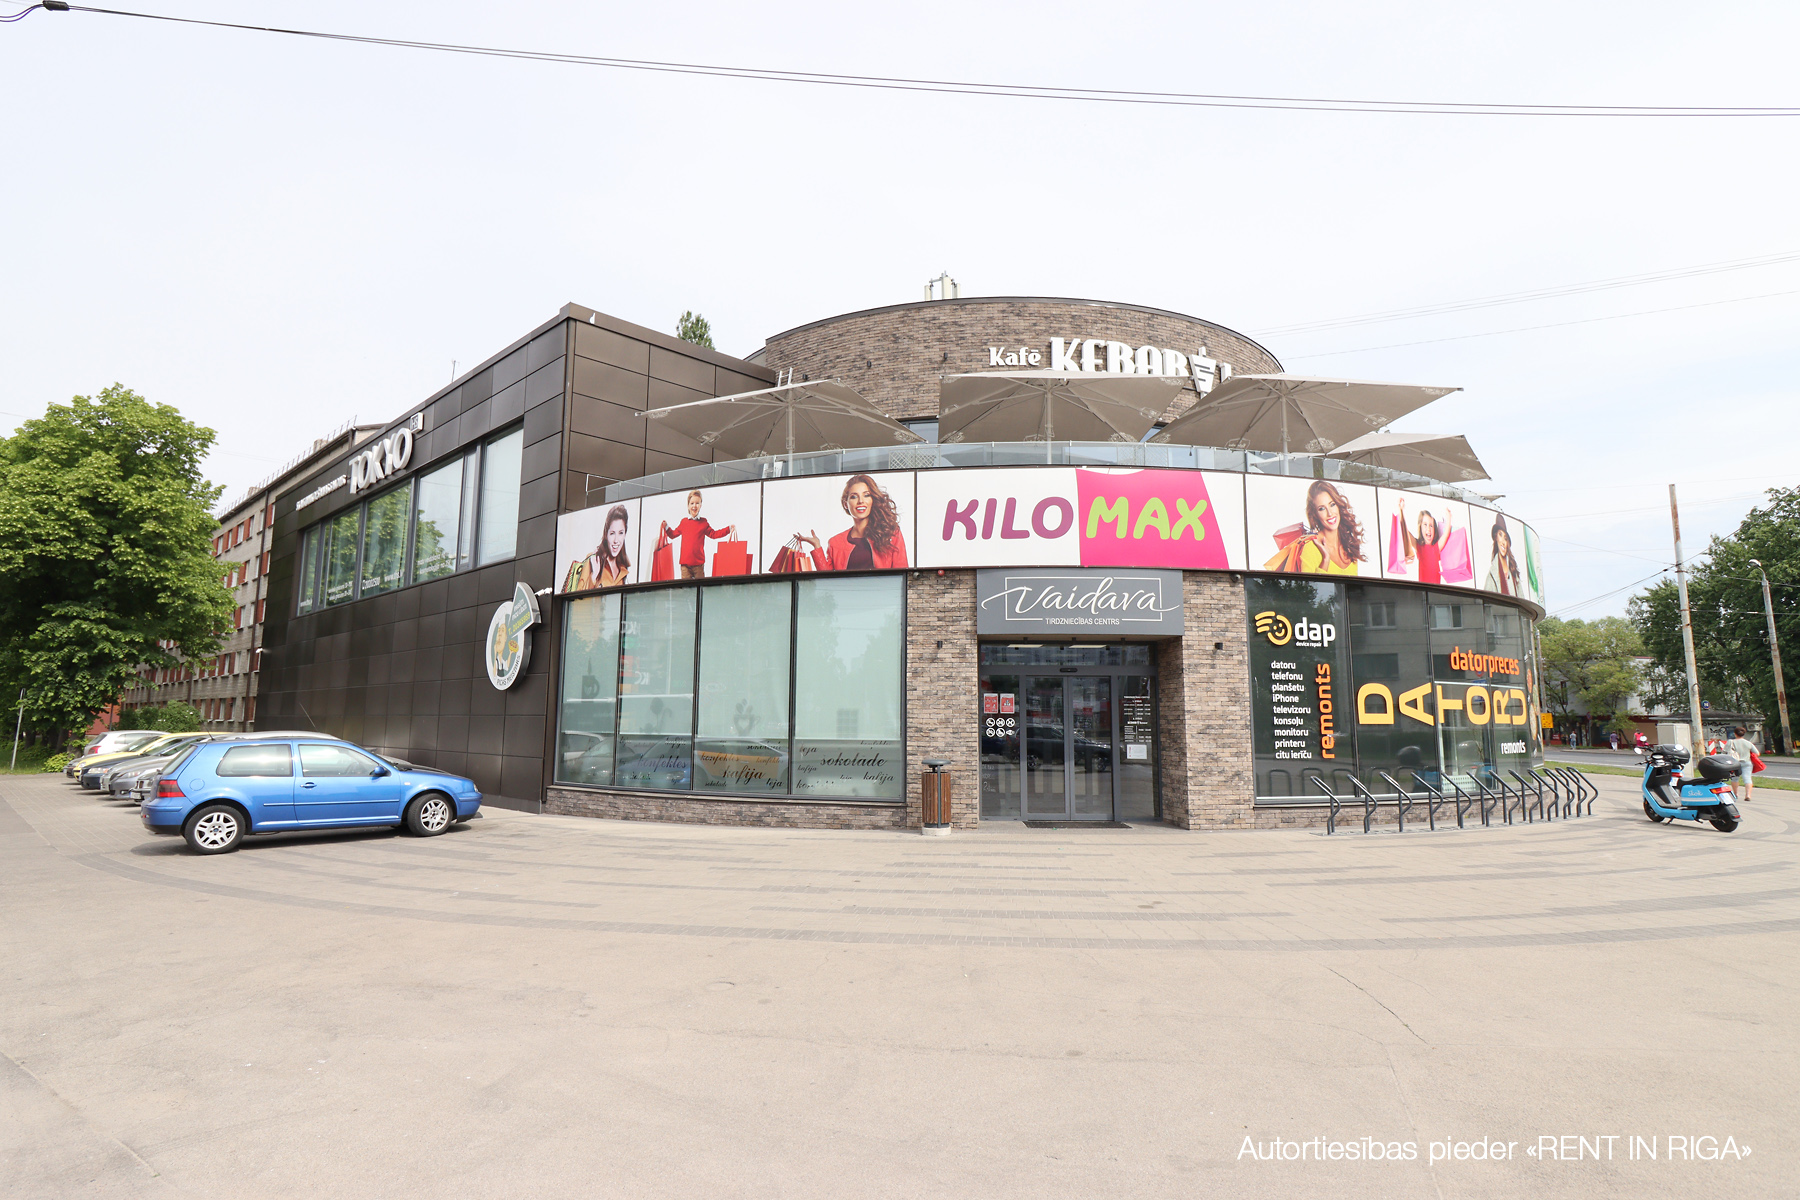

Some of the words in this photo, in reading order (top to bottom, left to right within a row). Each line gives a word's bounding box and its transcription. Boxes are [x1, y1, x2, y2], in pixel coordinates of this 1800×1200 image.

[989, 346, 1042, 366] Kafē
[349, 428, 413, 494] TOKYO
[981, 577, 1180, 614] Vaidava
[1045, 616, 1094, 625] TIRDZNIECĪBAS
[1094, 617, 1120, 626] CENTRS
[1294, 616, 1336, 648] dap
[1270, 660, 1296, 669] datoru
[1450, 646, 1520, 678] datorpreces
[1271, 672, 1303, 680] telefonu
[1271, 683, 1305, 692] planšetu
[1272, 694, 1300, 703] iPhone
[1357, 682, 1528, 726] DATORU
[1273, 705, 1311, 714] televizoru
[1315, 663, 1336, 759] remonts
[1274, 728, 1309, 737] monitoru
[1274, 738, 1306, 750] printeru
[1500, 740, 1527, 755] remonts
[1275, 750, 1290, 759] citu
[1290, 750, 1312, 759] ierīču
[722, 764, 767, 785] kafija
